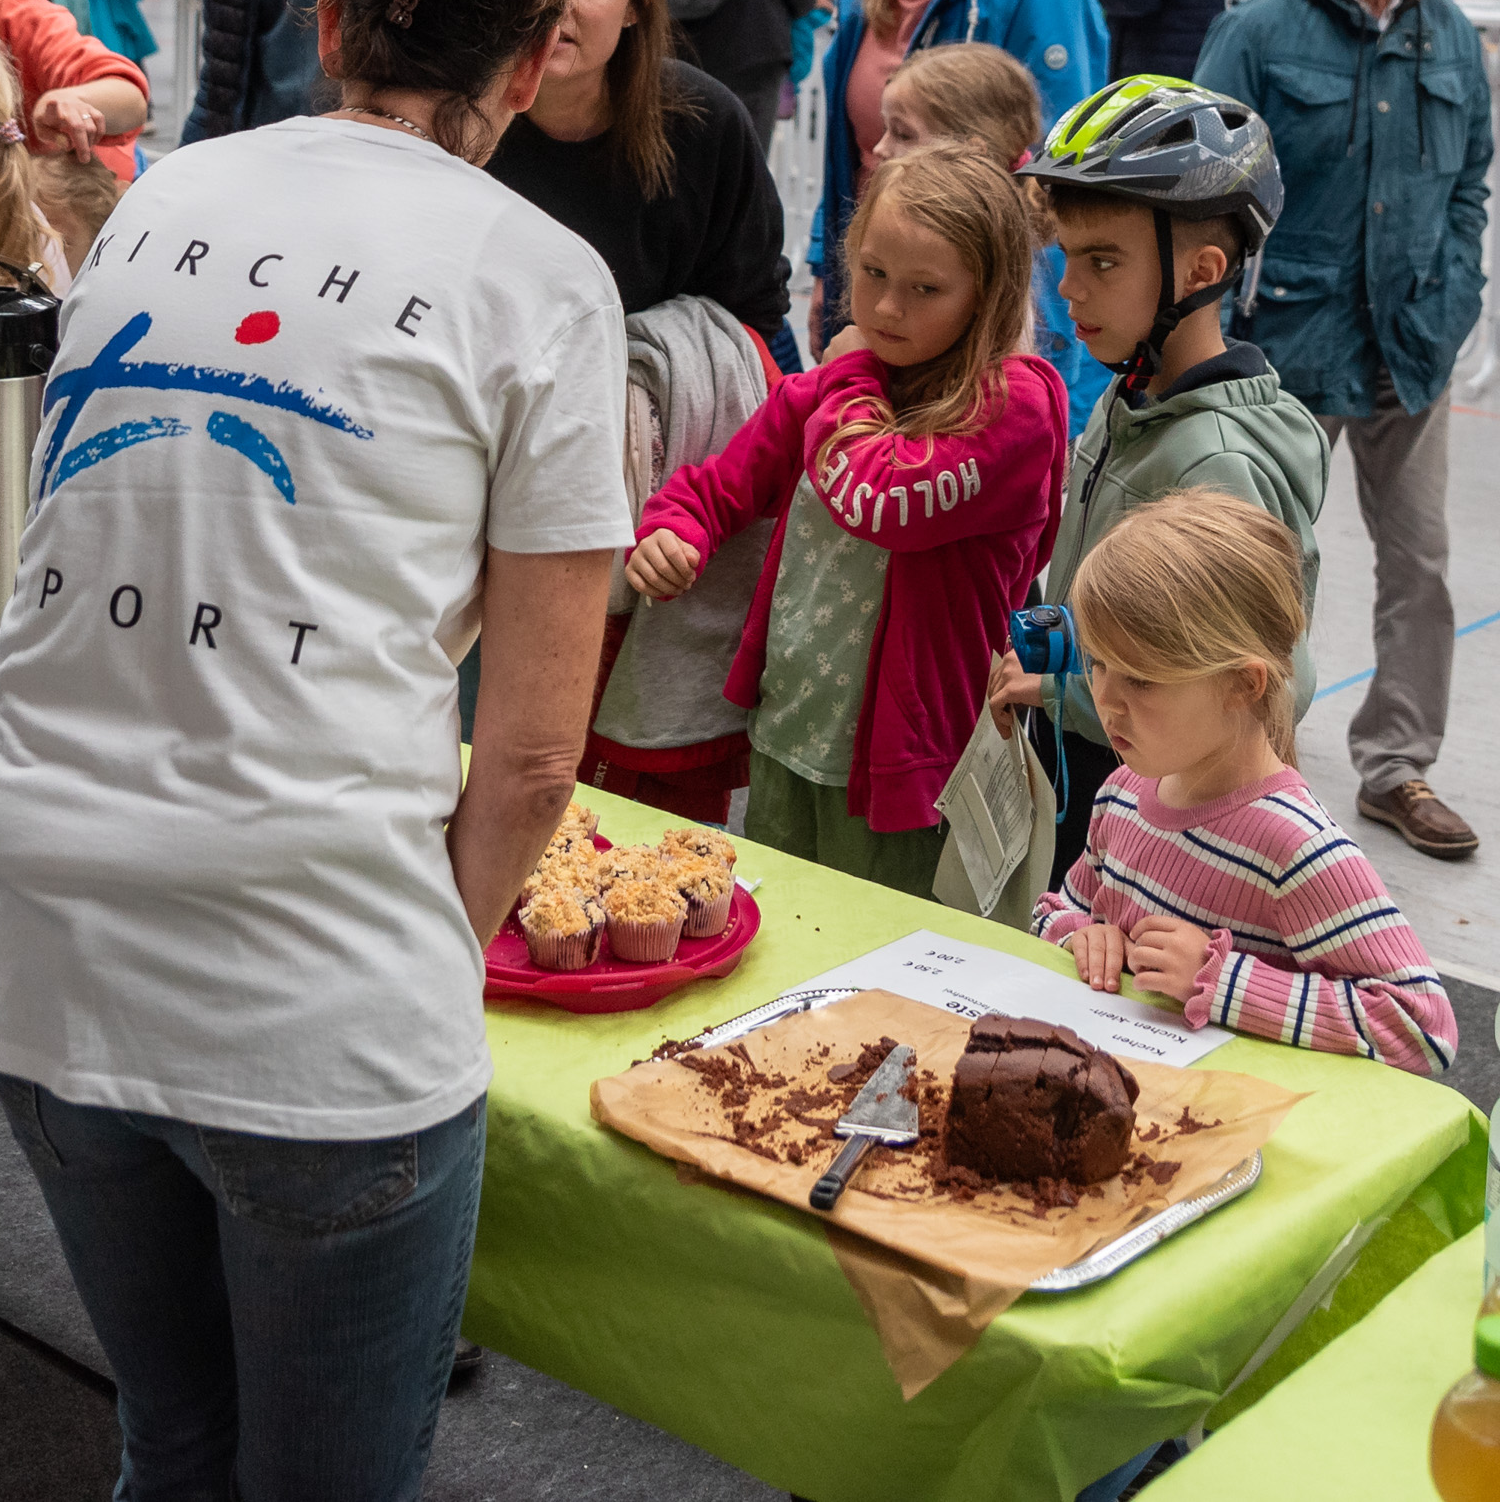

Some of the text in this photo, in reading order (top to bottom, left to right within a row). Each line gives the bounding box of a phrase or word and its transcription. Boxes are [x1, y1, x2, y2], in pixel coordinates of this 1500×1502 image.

[89, 231, 433, 338] KIRCHE
[818, 441, 982, 534] HOLLISTE
[14, 556, 319, 665] PORT
[914, 964, 943, 975] 2,50
[937, 953, 966, 964] 2,00
[945, 1001, 982, 1018] ste
[1089, 1008, 1130, 1023] -klein-
[1134, 1021, 1187, 1044] Kuchen
[1112, 1034, 1166, 1056] Kuchen
